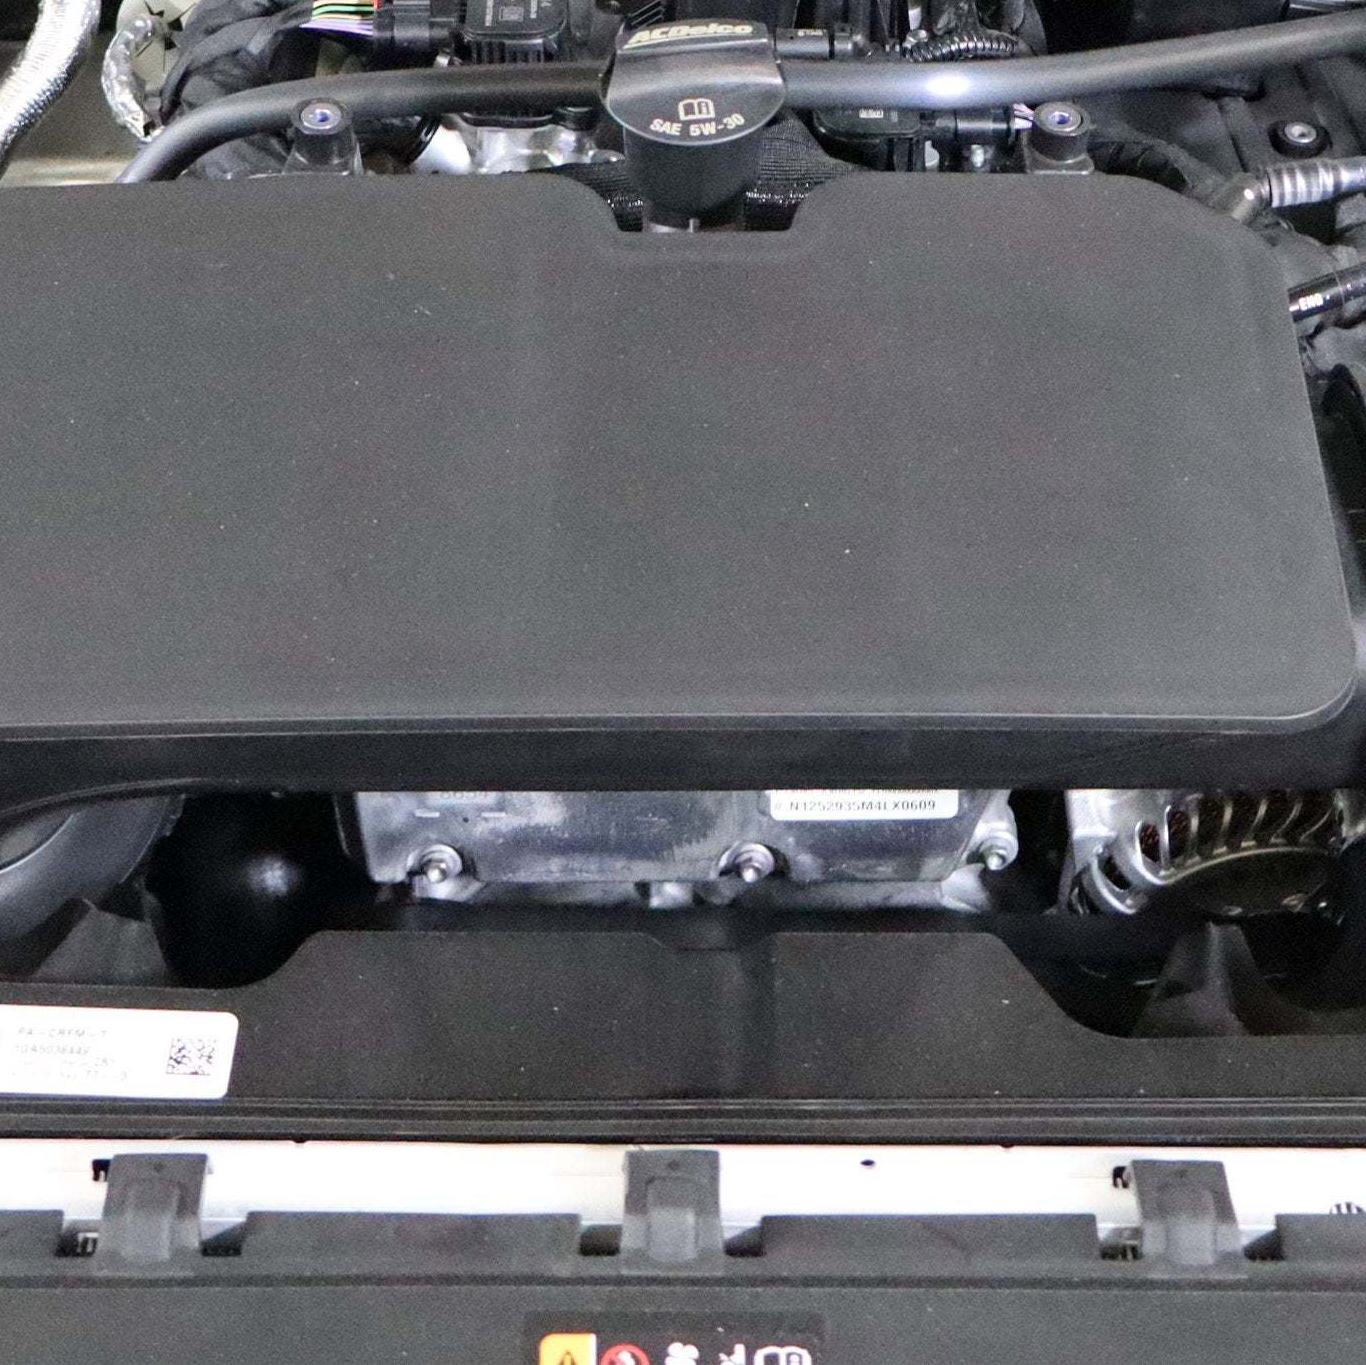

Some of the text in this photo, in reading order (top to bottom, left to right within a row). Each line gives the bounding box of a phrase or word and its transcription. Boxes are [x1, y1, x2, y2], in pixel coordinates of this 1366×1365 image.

[627, 22, 754, 47] ACDelco
[649, 112, 745, 137] SAE 5W-30
